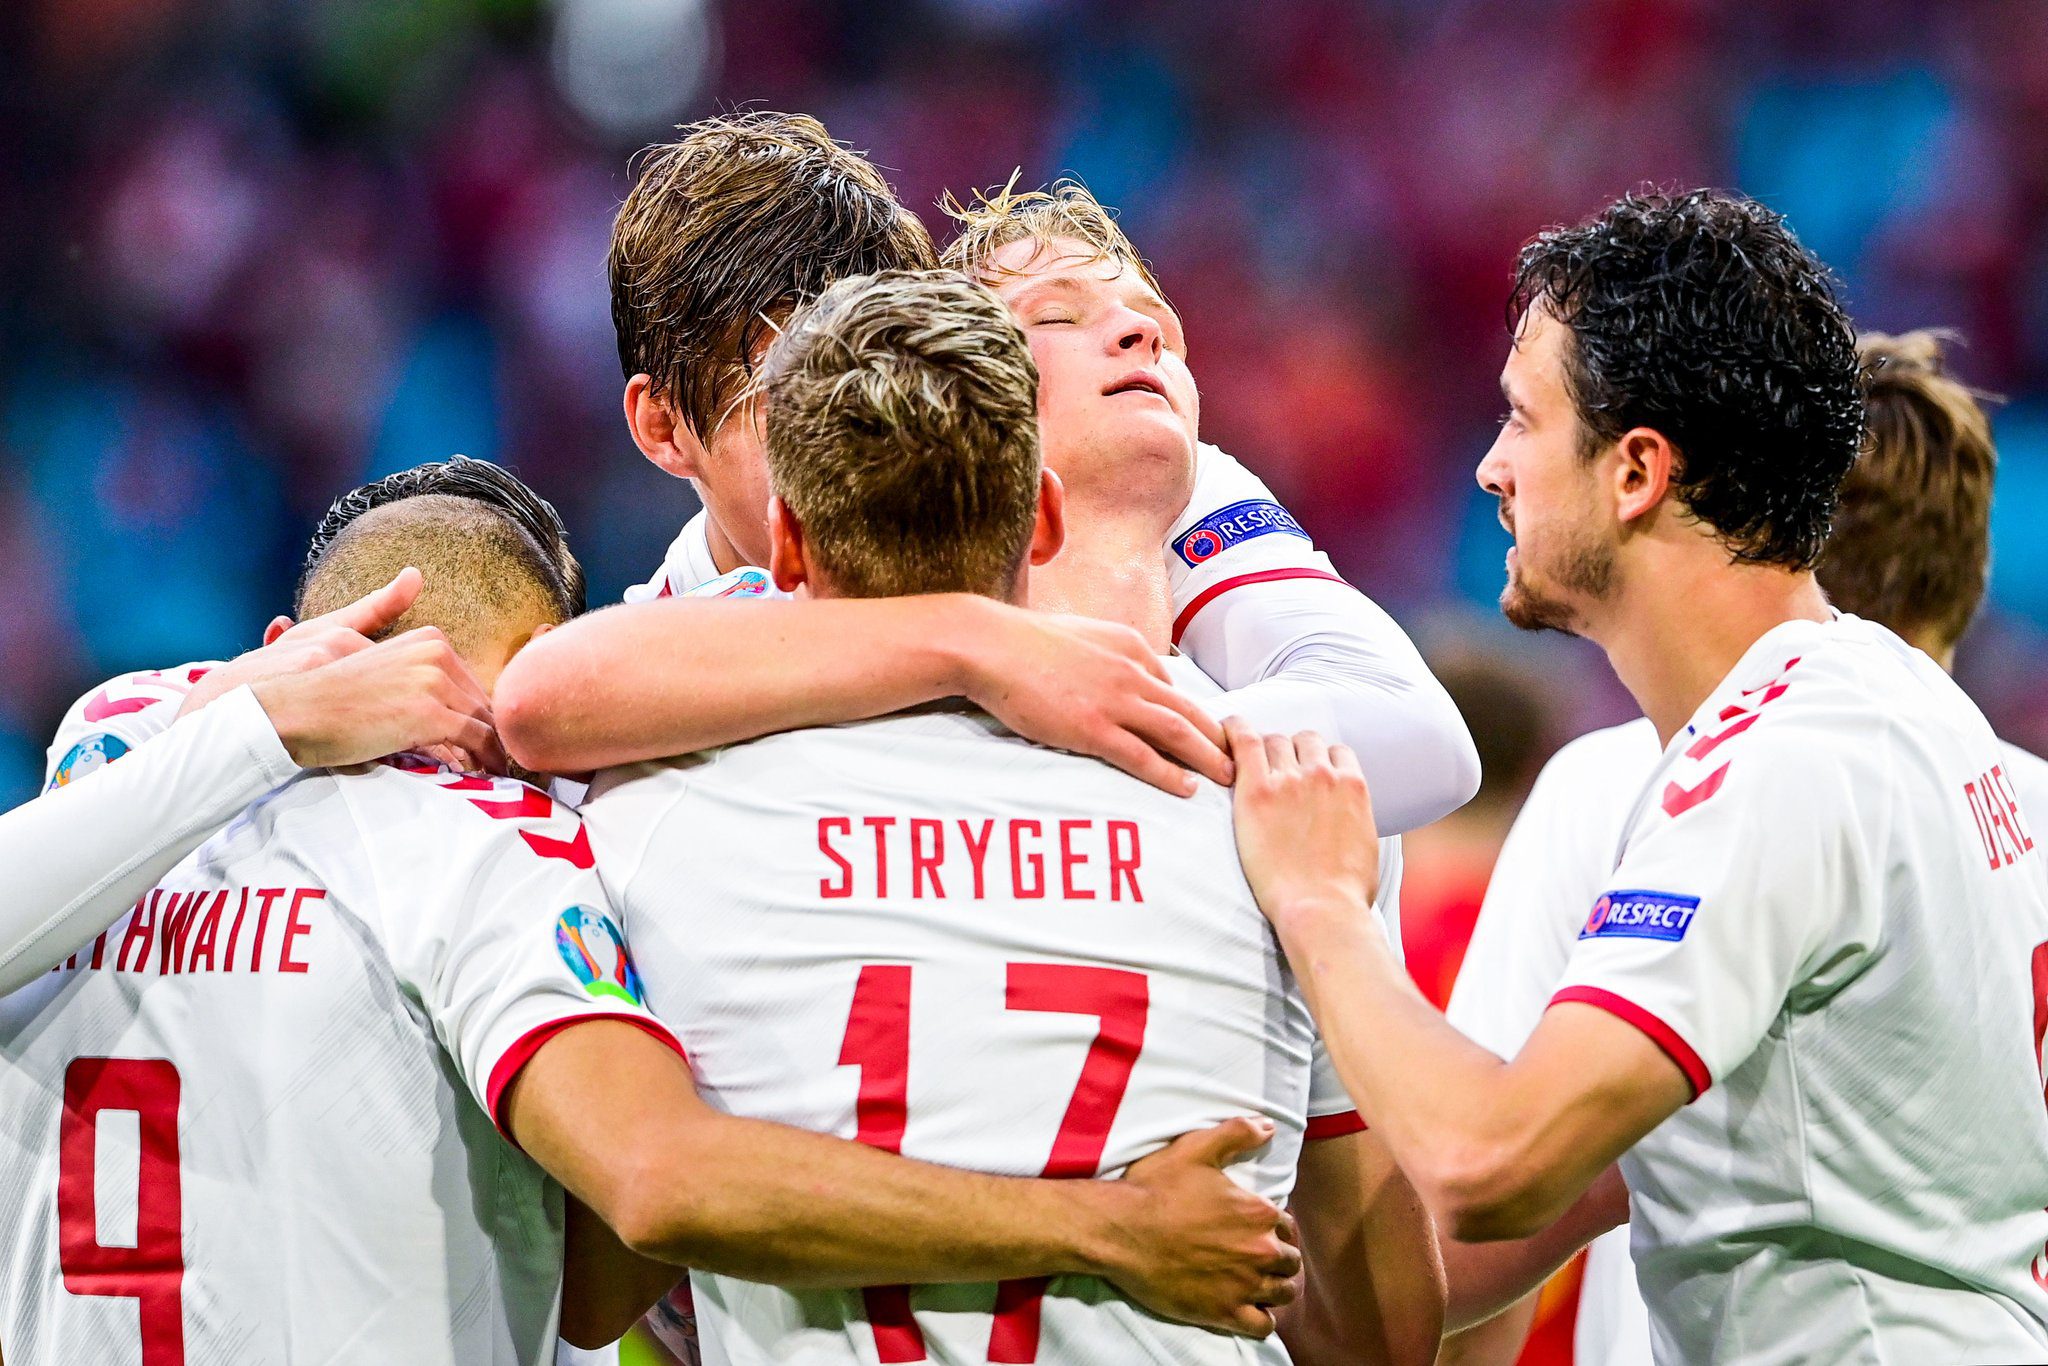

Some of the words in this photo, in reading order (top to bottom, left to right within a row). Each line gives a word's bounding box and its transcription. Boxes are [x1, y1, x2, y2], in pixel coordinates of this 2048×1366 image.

[1187, 531, 1207, 548] UEFA
[817, 816, 1145, 903] STRYGER
[1605, 902, 1695, 929] RESPECT
[837, 962, 1149, 1364] 17
[57, 1057, 185, 1366] 9
